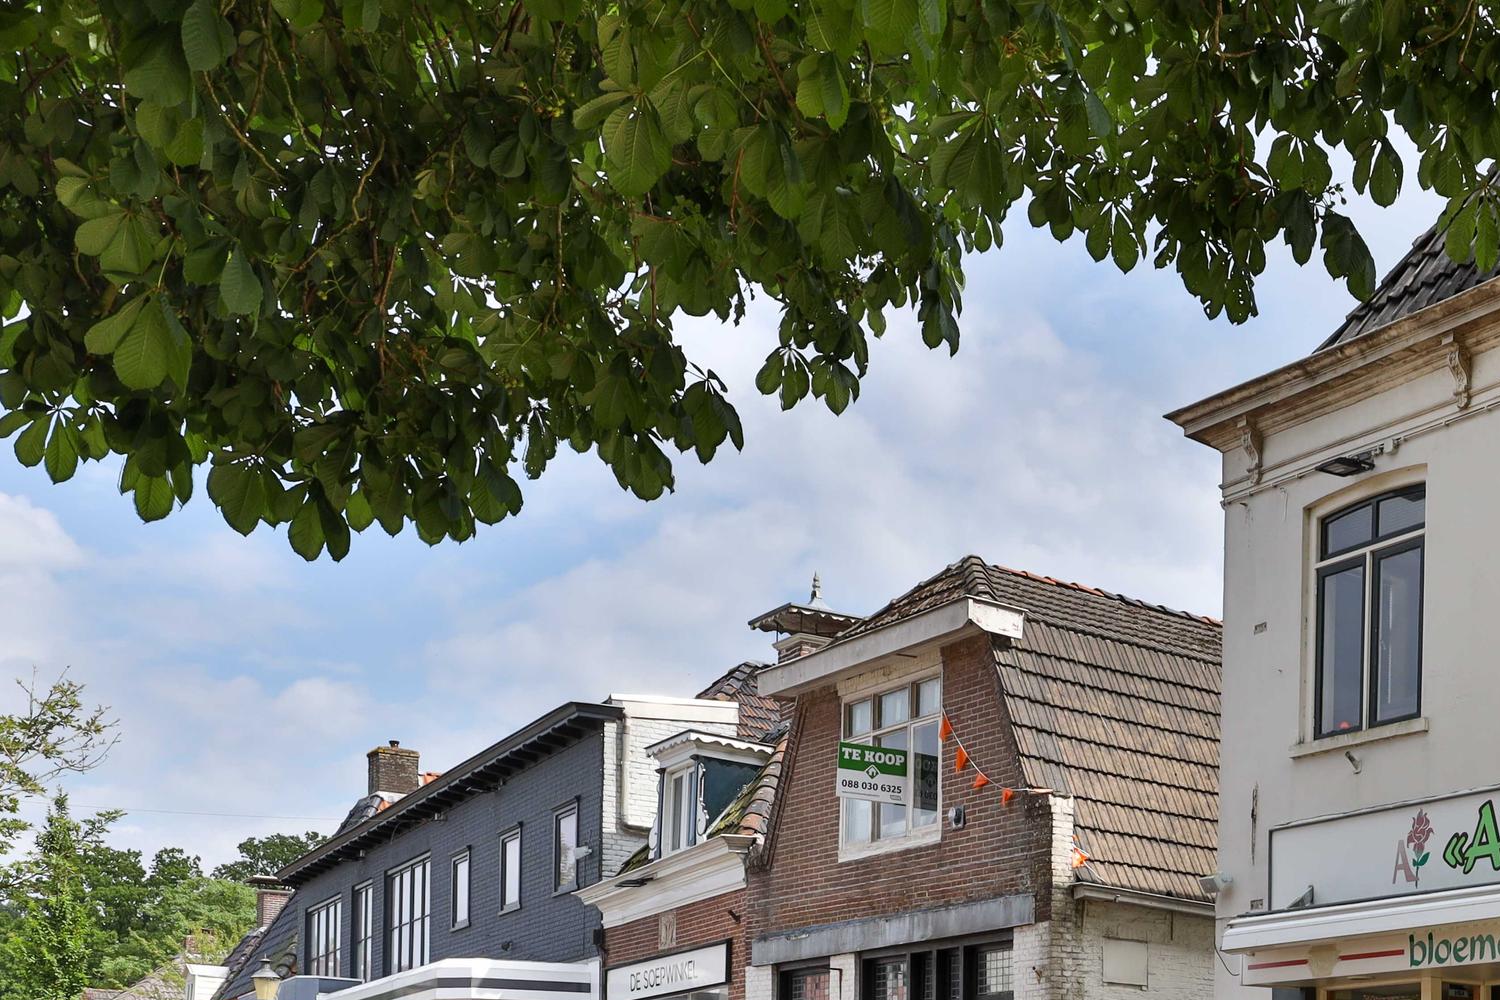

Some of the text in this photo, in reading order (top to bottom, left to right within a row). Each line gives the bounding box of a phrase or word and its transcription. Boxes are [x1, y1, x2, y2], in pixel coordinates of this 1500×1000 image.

[841, 747, 905, 766] TE KOOP
[841, 779, 859, 789] 088
[861, 781, 878, 791] 030
[880, 784, 902, 794] 6325
[629, 960, 698, 992] DE SOEPWINKEL
